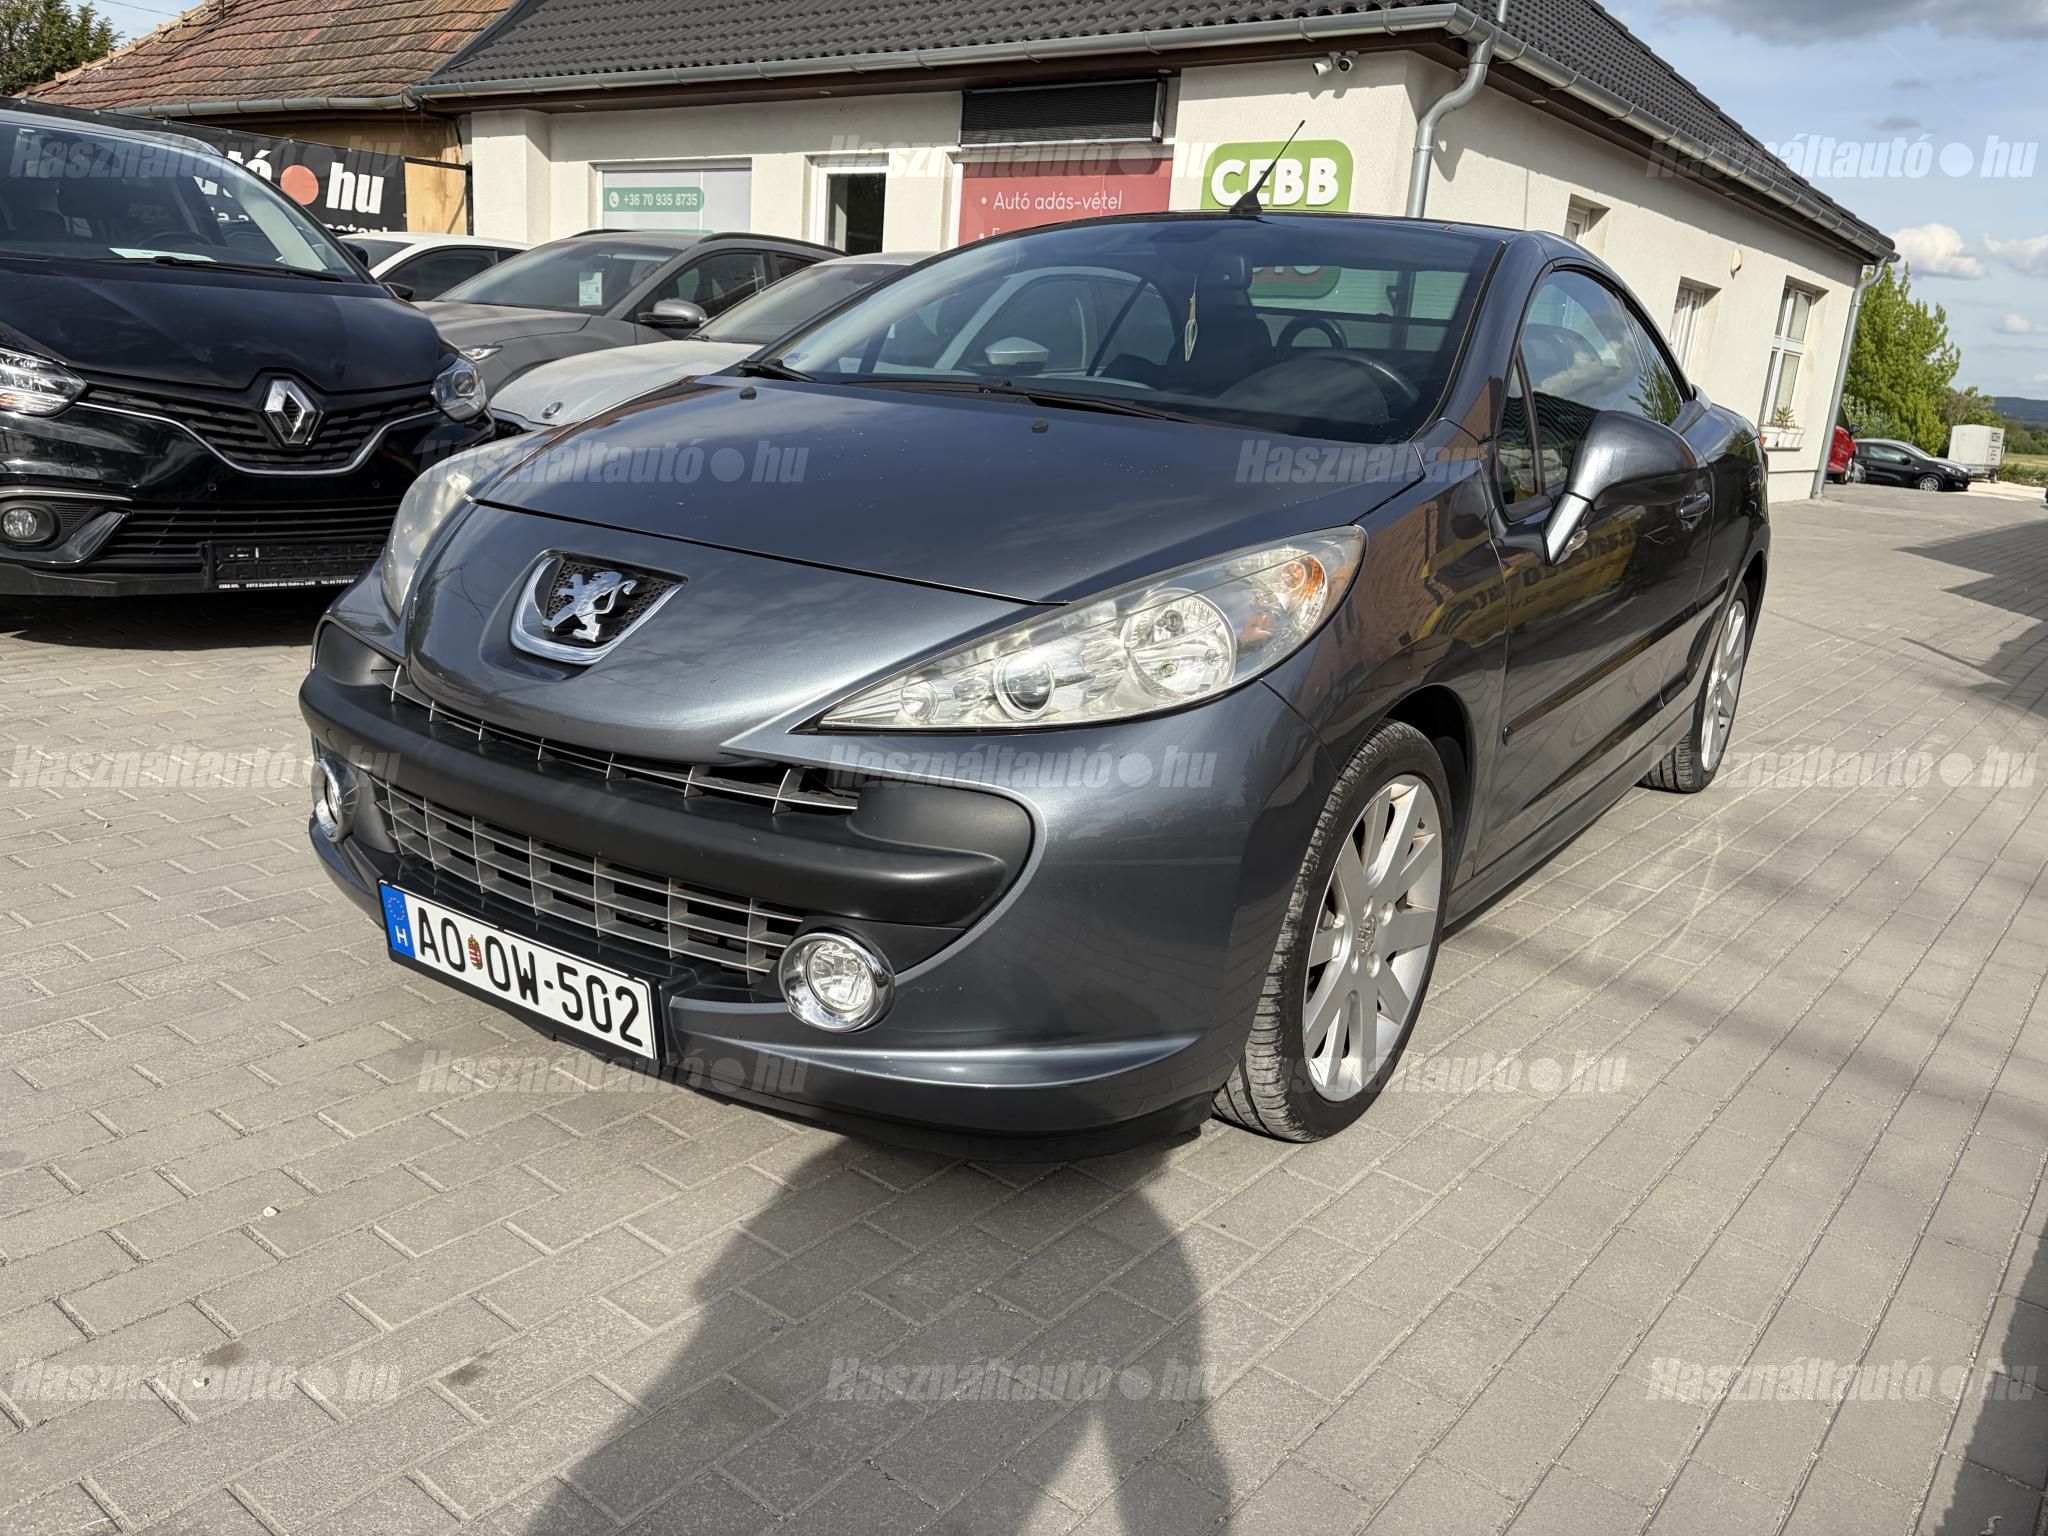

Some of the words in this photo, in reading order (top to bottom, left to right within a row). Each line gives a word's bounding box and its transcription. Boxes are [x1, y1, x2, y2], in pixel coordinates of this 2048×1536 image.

[326, 162, 384, 214] hu
[1211, 157, 1339, 206] CEBB
[624, 193, 640, 206] +36
[642, 193, 653, 206] 70
[656, 193, 673, 206] 935
[675, 193, 698, 206] 8735
[993, 191, 1031, 210] Autó
[1035, 190, 1123, 210] adás-vétel
[395, 925, 408, 947] H
